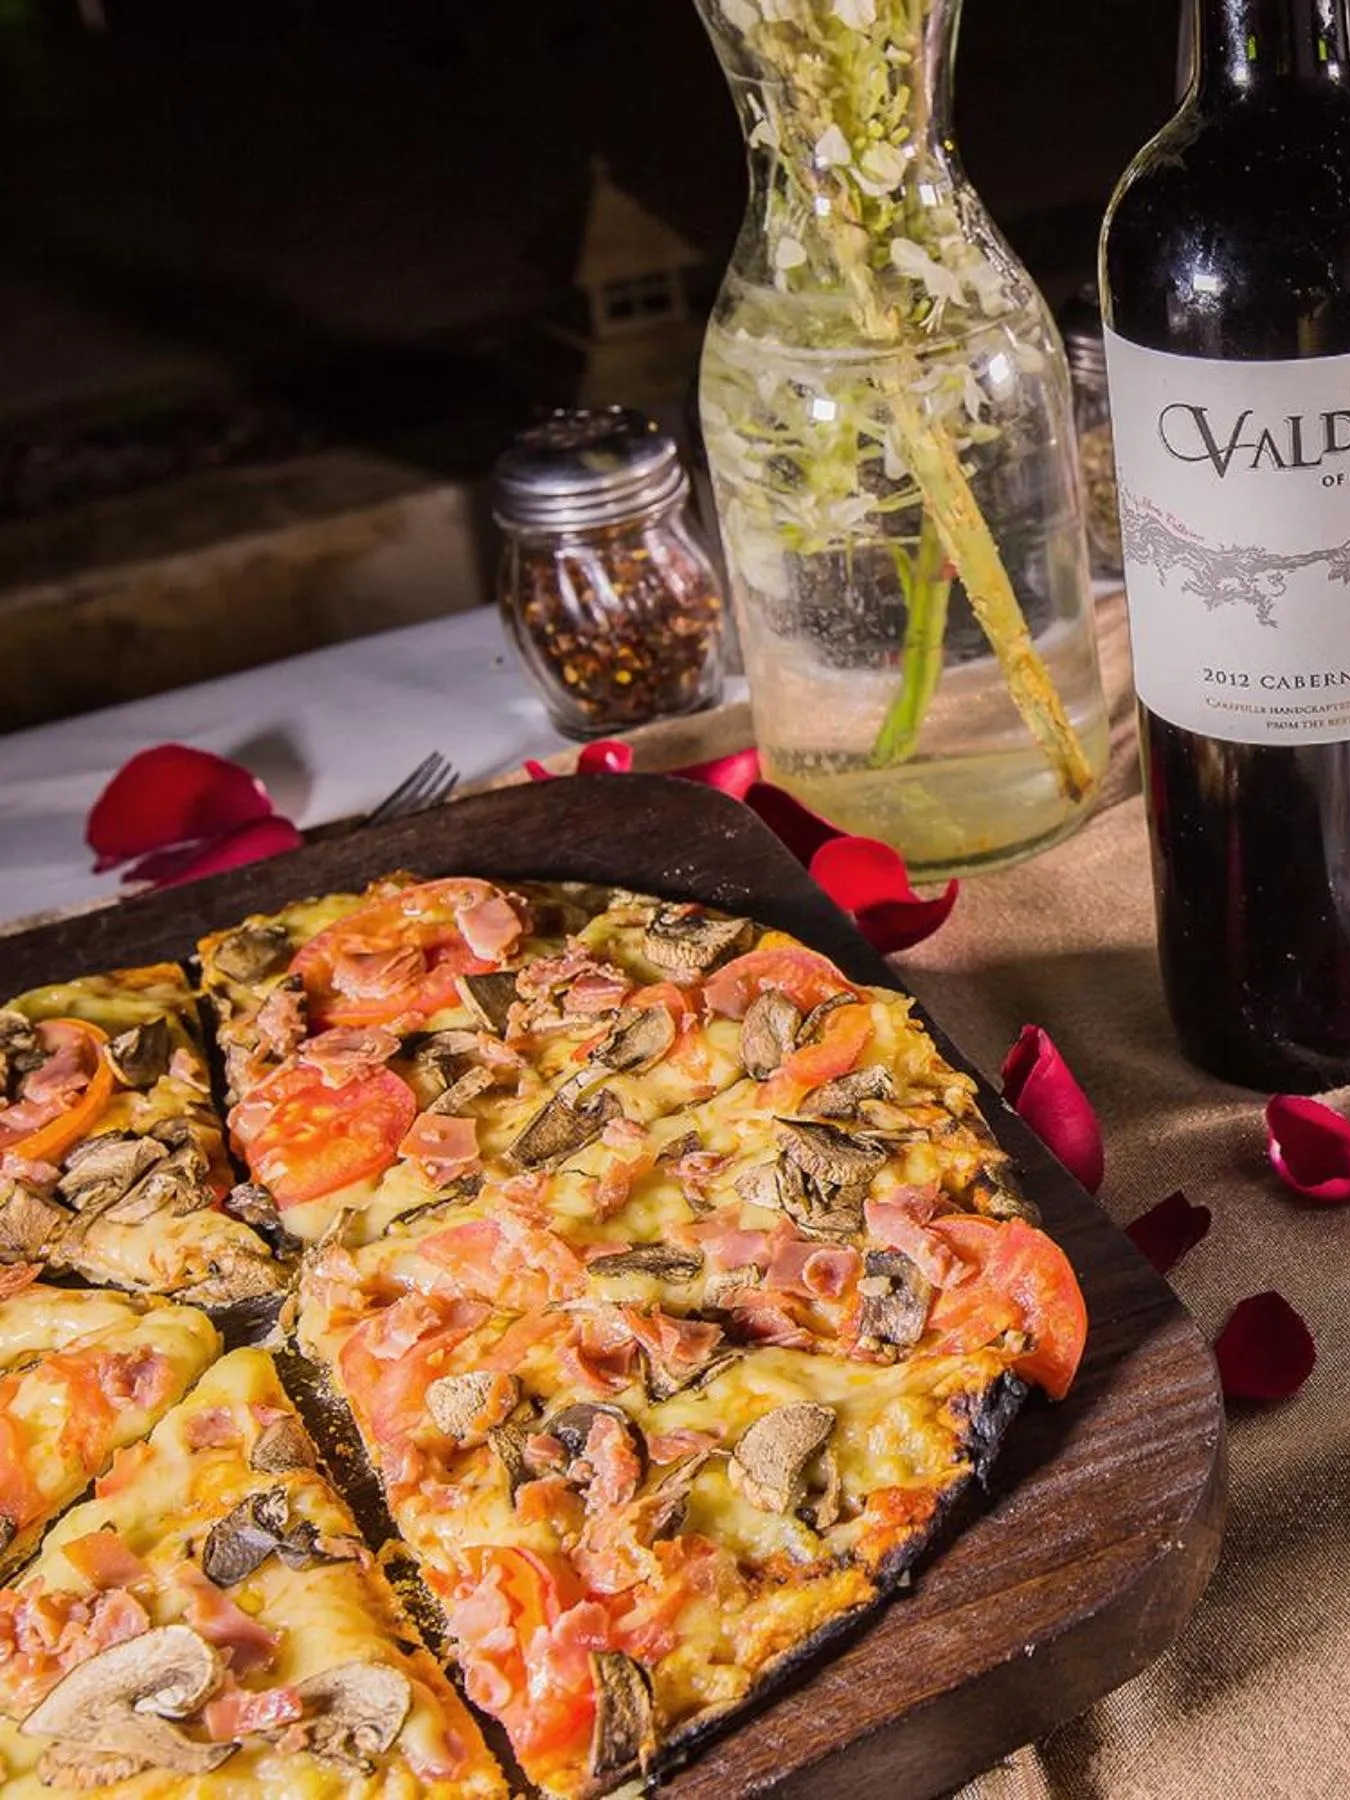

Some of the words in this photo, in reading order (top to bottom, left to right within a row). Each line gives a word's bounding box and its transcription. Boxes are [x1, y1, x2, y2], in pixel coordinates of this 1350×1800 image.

[1322, 473, 1345, 488] OF
[1203, 667, 1250, 688] 2012
[1266, 719, 1299, 730] FROM
